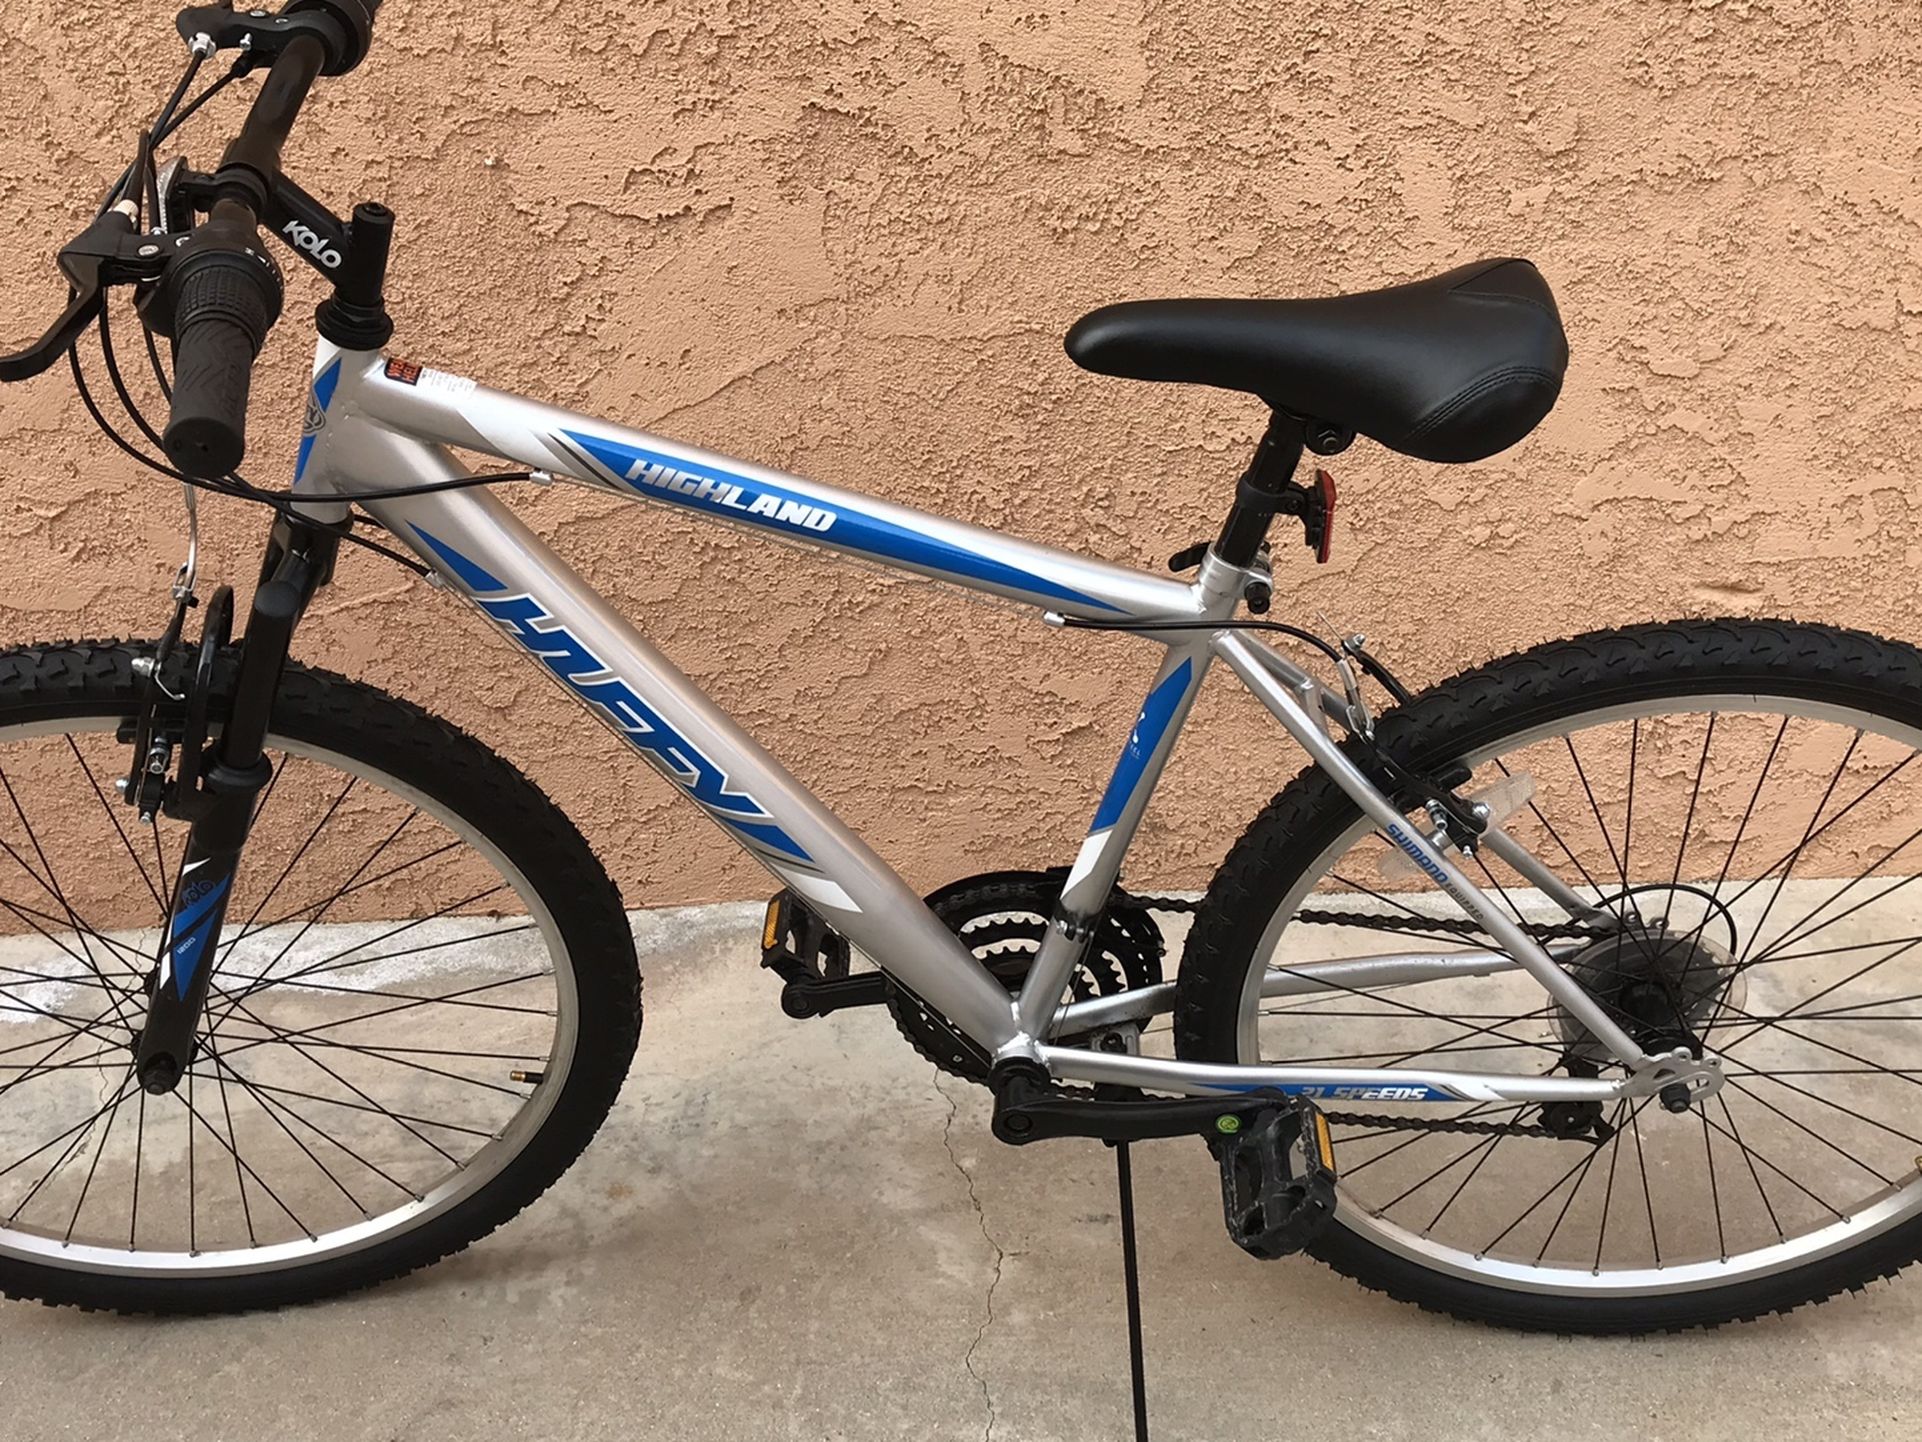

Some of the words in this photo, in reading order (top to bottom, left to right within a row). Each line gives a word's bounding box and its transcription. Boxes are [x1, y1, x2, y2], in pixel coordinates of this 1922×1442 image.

[282, 219, 342, 269] KOLO
[625, 459, 838, 532] HIGHLAND
[475, 593, 774, 818] HUFFY
[1387, 823, 1449, 884] SHIMANO
[1446, 883, 1484, 920] EQUIPPED
[1331, 1086, 1429, 1100] SPEEDS
